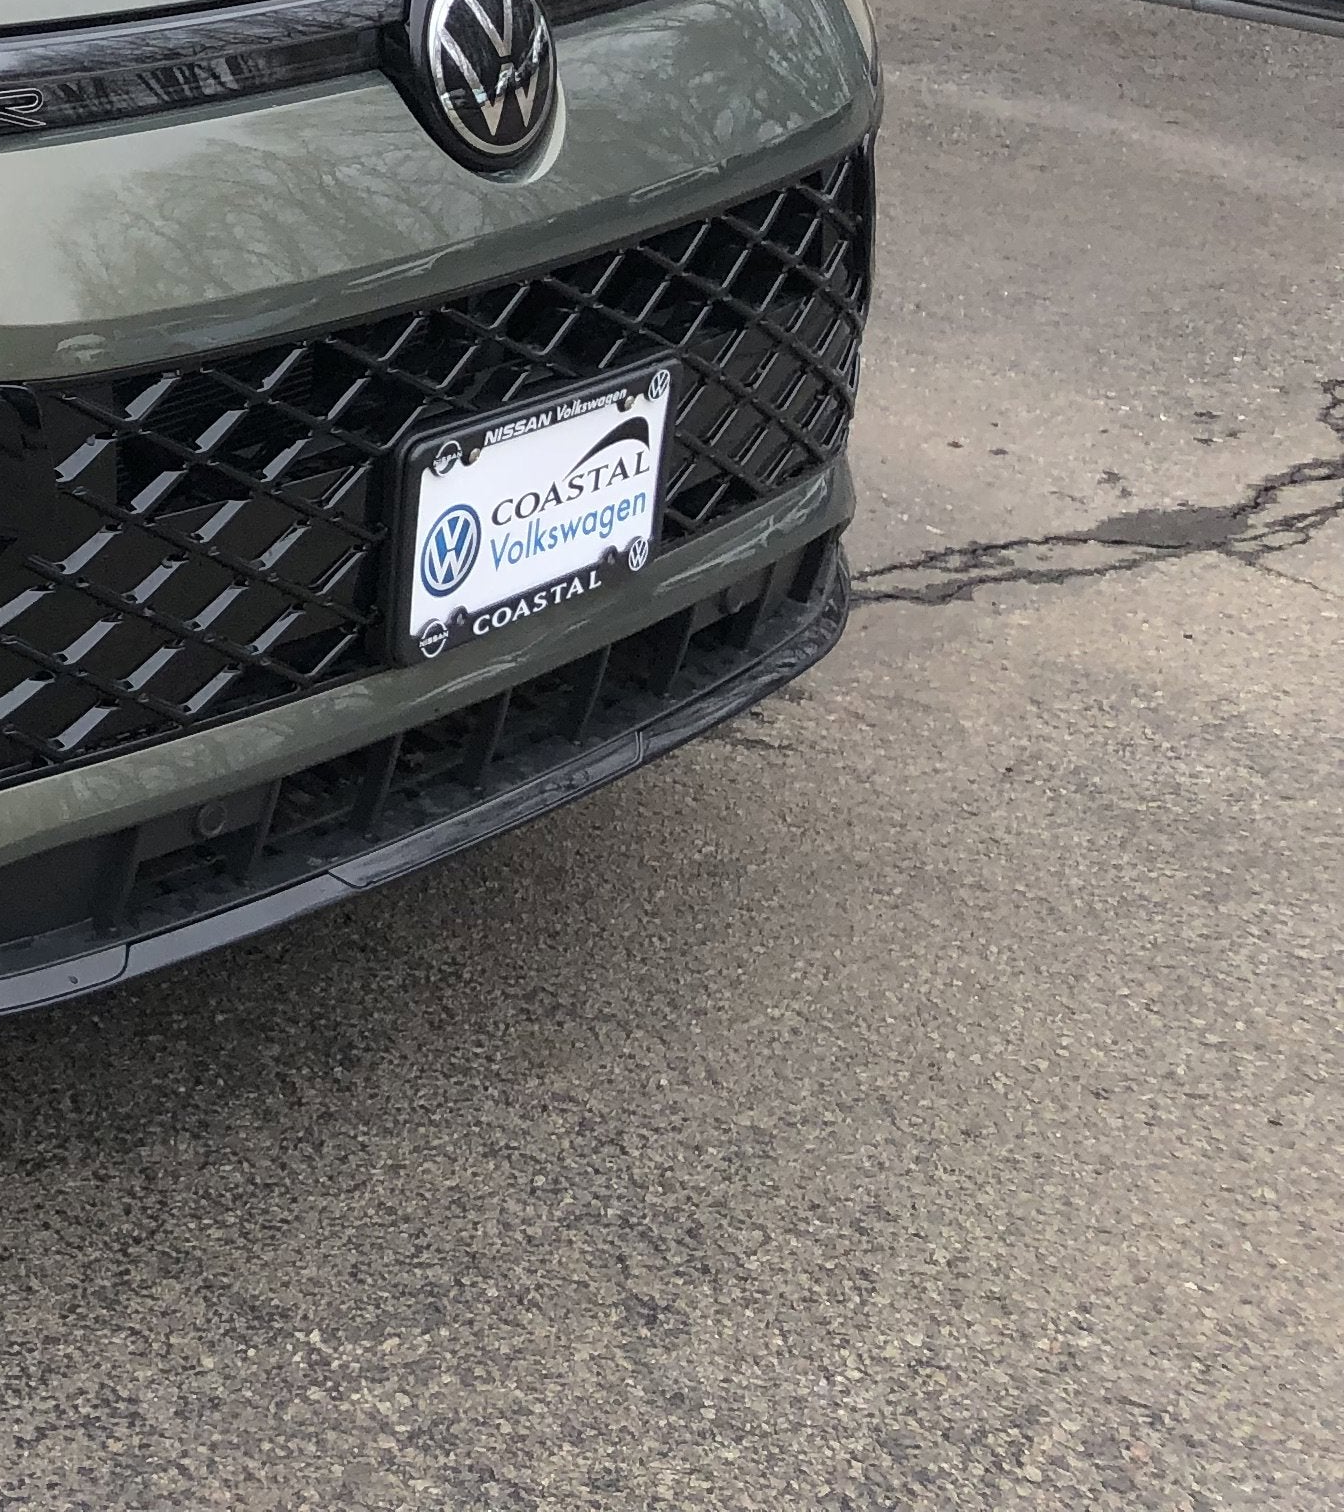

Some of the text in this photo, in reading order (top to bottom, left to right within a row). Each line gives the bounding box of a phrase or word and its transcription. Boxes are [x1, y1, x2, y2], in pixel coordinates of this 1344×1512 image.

[484, 389, 627, 446] NISSAN Volkswagen
[492, 451, 650, 525] COASTAL
[490, 492, 646, 571] Volkswagen
[473, 571, 602, 635] COASTAL
